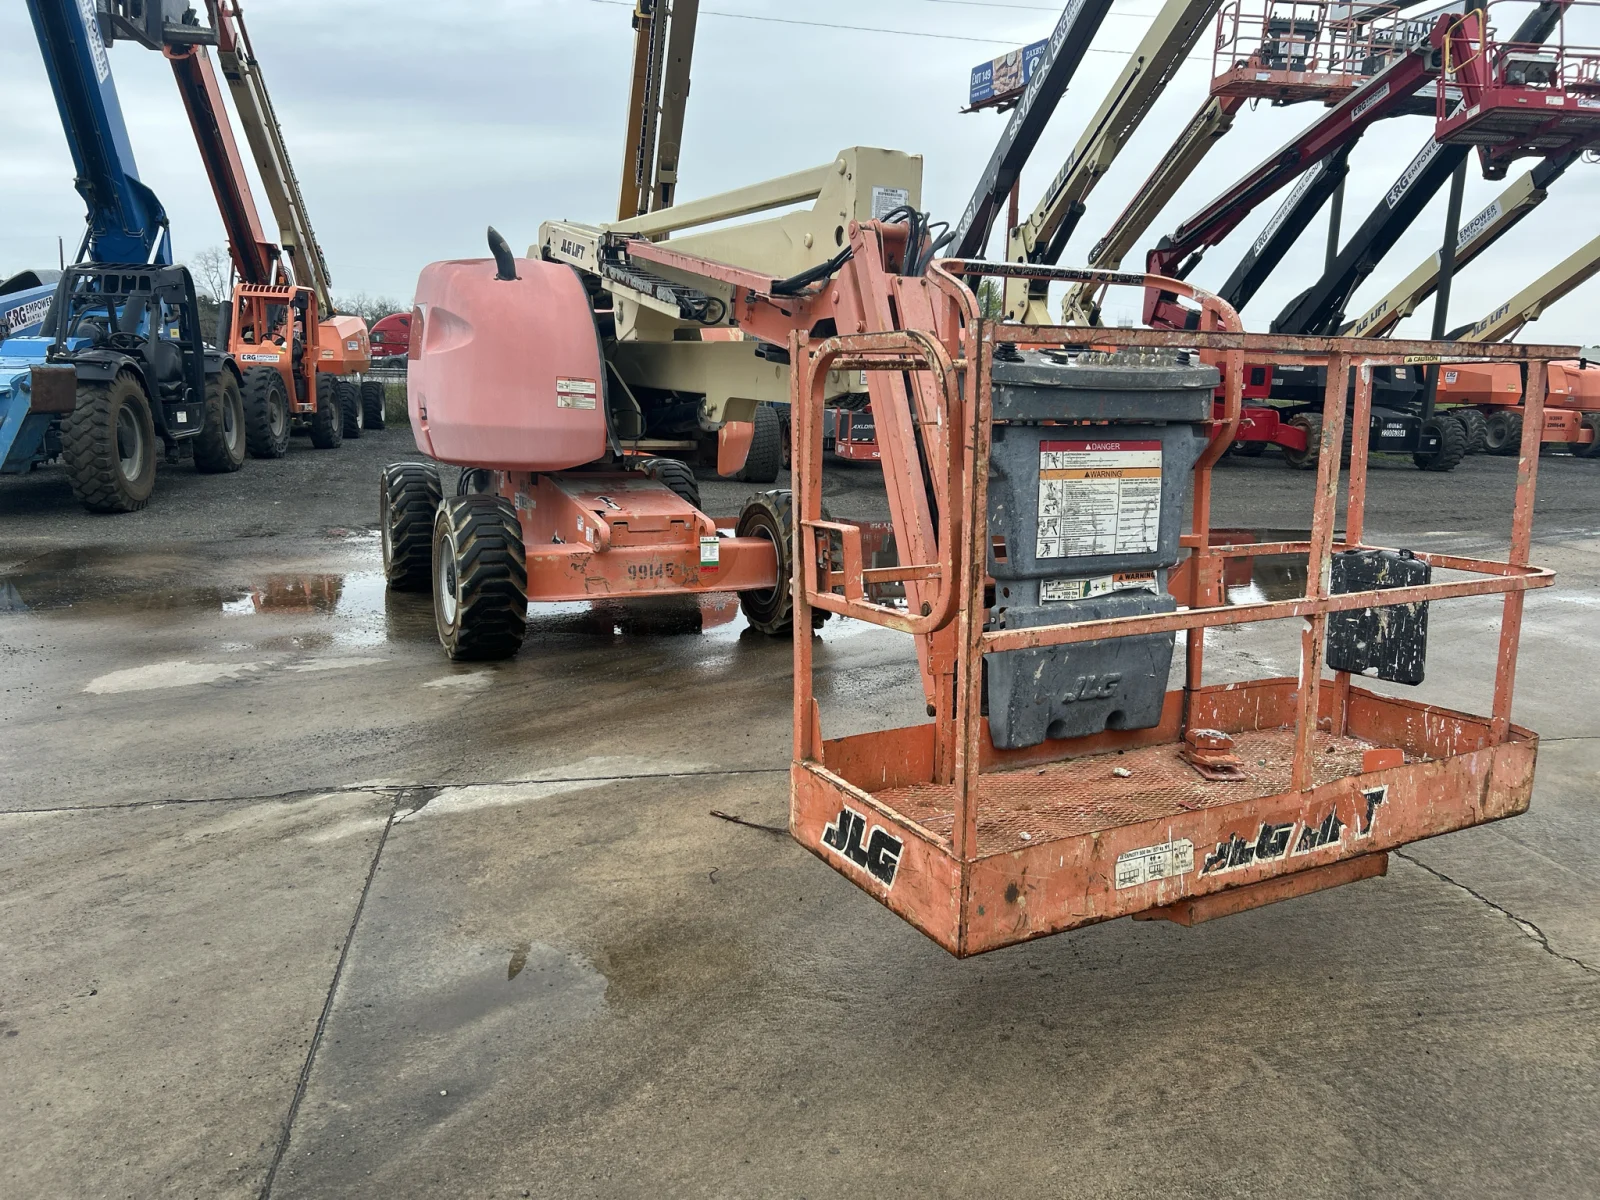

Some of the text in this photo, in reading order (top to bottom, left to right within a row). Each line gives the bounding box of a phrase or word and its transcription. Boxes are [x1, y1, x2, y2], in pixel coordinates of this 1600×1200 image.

[972, 69, 991, 86] EXIT 149
[1009, 55, 1050, 141] SKYJACK
[1059, 152, 1076, 180] LIFT
[1386, 141, 1438, 207] ERG EMPOWE
[1253, 230, 1269, 254] ERG
[1267, 205, 1288, 236] EMPOWER
[1286, 182, 1306, 208] RENTAL
[1459, 204, 1497, 239] EMPOWER
[571, 242, 586, 260] LIFT
[6, 306, 28, 329] ERG
[1355, 300, 1389, 336] JLG LIFT
[1472, 303, 1511, 338] JLG LIFT
[1091, 442, 1121, 450] DANGER
[1090, 470, 1123, 478] WARNING
[1124, 571, 1155, 580] WARNING
[1061, 671, 1121, 705] JLG
[819, 804, 905, 892] JLG
